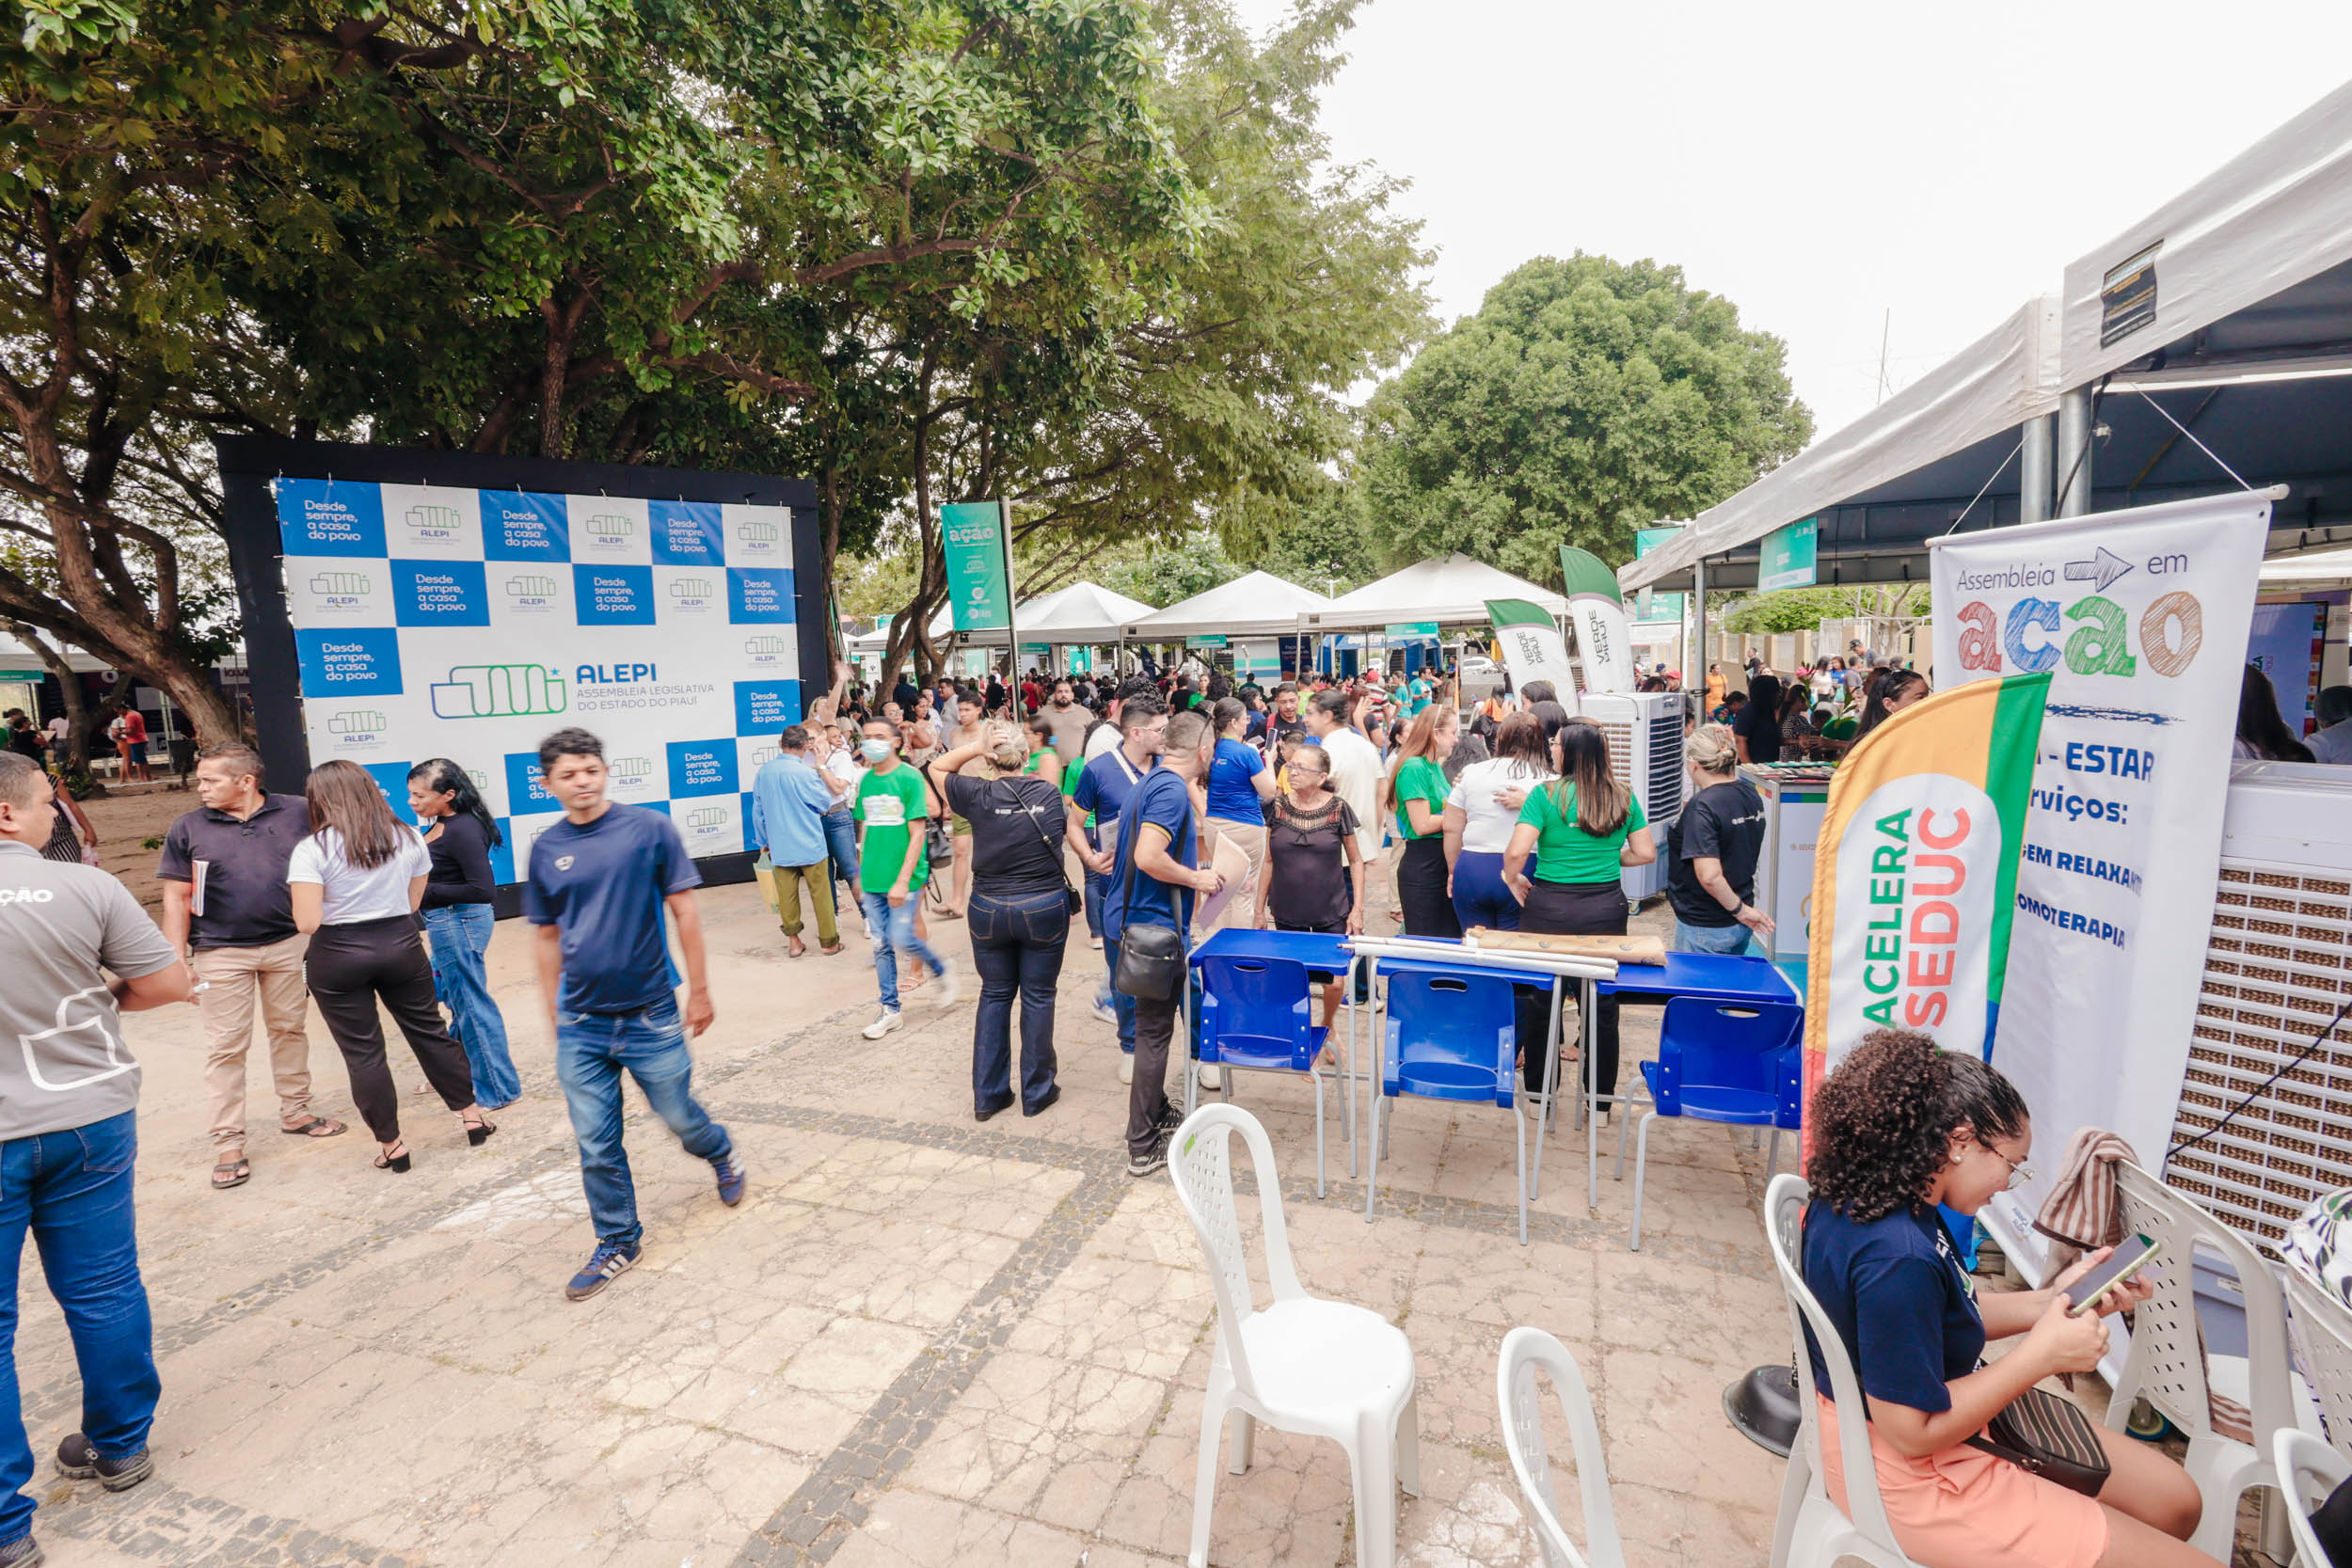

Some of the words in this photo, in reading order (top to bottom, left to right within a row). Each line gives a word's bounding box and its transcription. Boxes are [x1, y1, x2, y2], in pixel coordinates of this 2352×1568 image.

[305, 500, 346, 512] Desde
[306, 512, 358, 523] sempre,
[502, 510, 538, 521] Desde
[307, 522, 316, 531] a
[320, 522, 351, 531] casa
[503, 521, 548, 531] sempre,
[668, 519, 698, 528] Desde
[309, 531, 326, 541] do
[328, 532, 361, 543] povo
[505, 538, 520, 546] do
[522, 539, 549, 548] povo
[1957, 562, 2056, 591] Assembleia
[2147, 554, 2188, 575] em
[416, 574, 453, 584] Desde
[594, 578, 626, 586] Desde
[743, 579, 771, 588] Desde
[416, 584, 464, 594] sempre,
[595, 586, 634, 596] sempre,
[429, 594, 457, 602] casa
[419, 602, 435, 611] do
[437, 603, 467, 612] povo
[596, 603, 610, 611] do
[612, 604, 637, 612] povo
[1588, 610, 1604, 664] VERDE
[322, 642, 363, 653] Desde
[1517, 632, 1534, 666] VERDE
[324, 653, 374, 663] sempre,
[325, 663, 333, 672] a
[335, 662, 367, 671] casa
[326, 672, 343, 681] do
[346, 672, 377, 682] povo
[576, 663, 657, 684] ALEPI
[577, 687, 647, 699] ASSEMBLEIA
[649, 684, 714, 695] LEGISLATIVA
[578, 700, 596, 711] DO
[600, 698, 647, 709] ESTADO
[649, 697, 667, 707] DO
[670, 695, 697, 705] PIAUÍ
[765, 715, 786, 723] povo
[685, 752, 713, 762] Desde
[685, 761, 721, 769] sempre,
[2066, 742, 2154, 783] ESTAR
[687, 776, 699, 784] do
[700, 775, 723, 784] povo
[530, 790, 545, 799] do
[1863, 807, 1913, 1029] ACELERA
[1904, 806, 1971, 1027] SEDUC
[2015, 893, 2124, 950] OMOTERAPIA
